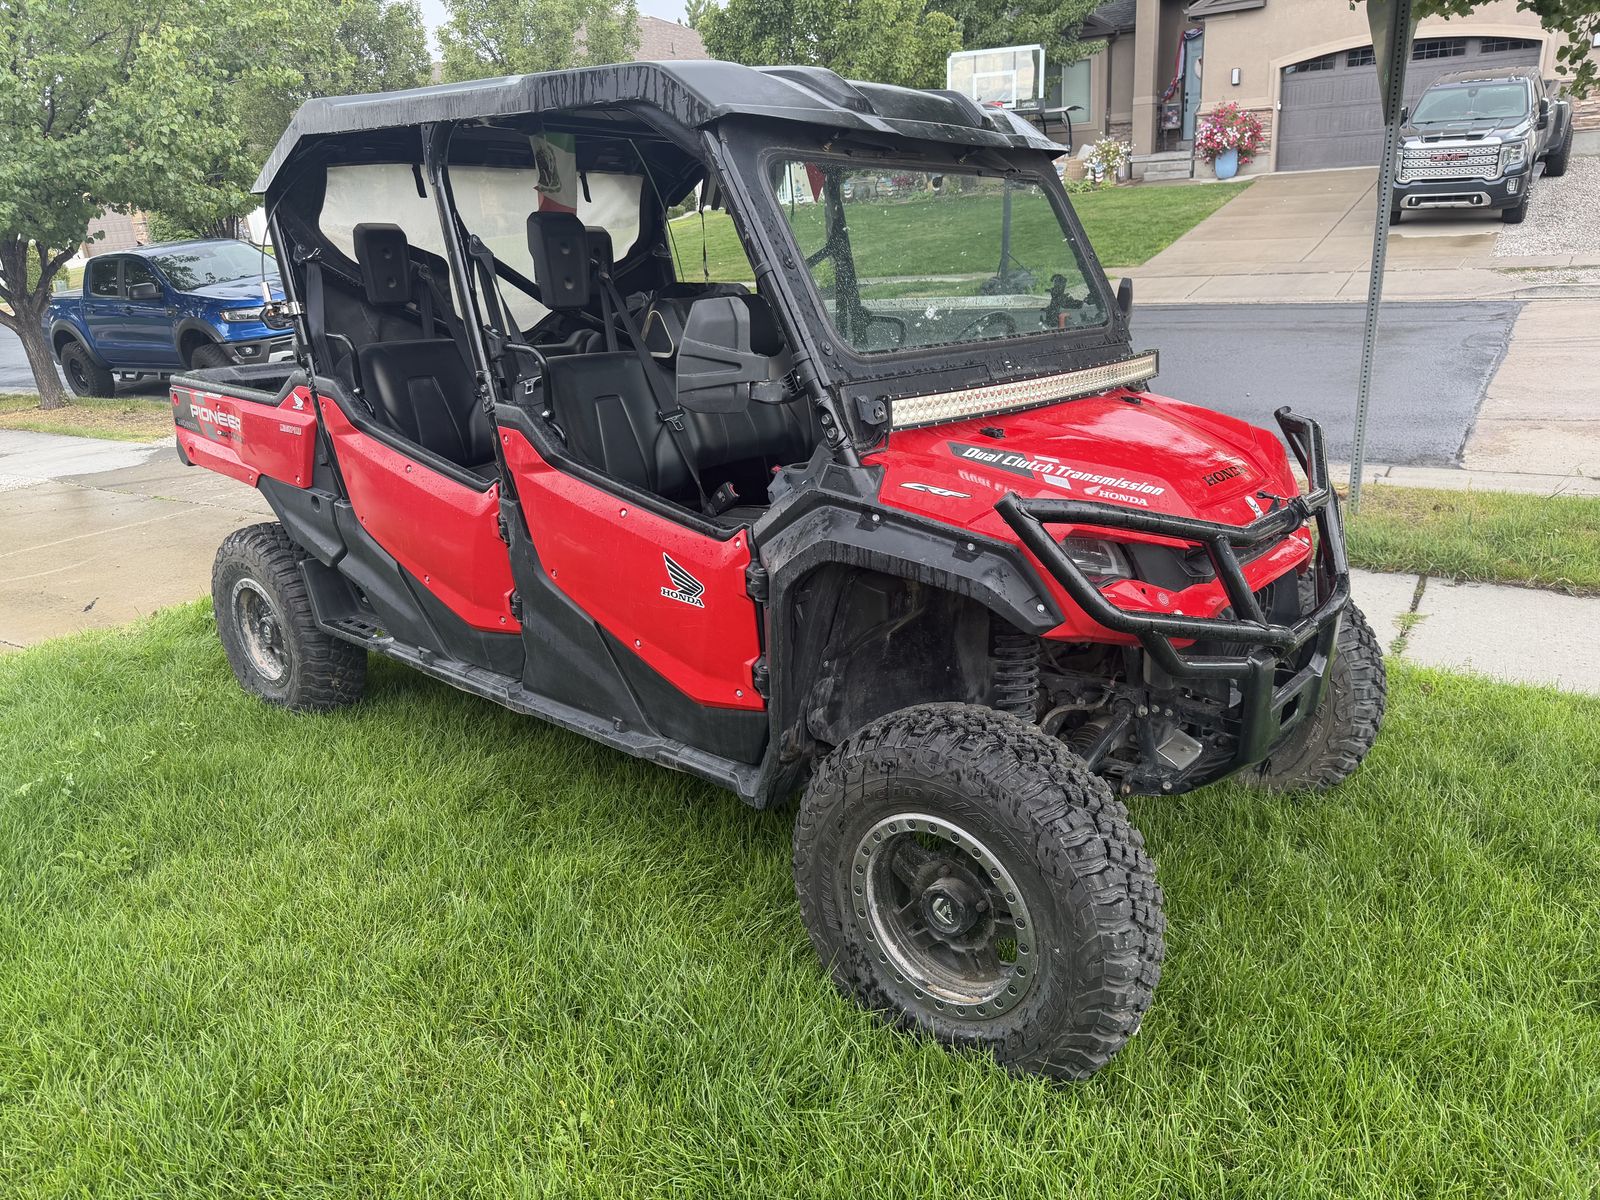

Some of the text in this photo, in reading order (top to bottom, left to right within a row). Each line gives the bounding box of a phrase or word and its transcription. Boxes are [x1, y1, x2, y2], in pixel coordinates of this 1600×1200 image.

[1430, 153, 1468, 162] GMC
[190, 404, 241, 433] PIONEER
[962, 447, 1165, 496] Dual Clutch Transmission
[1202, 464, 1248, 487] HONDA
[1098, 489, 1149, 506] HONDA
[661, 587, 704, 607] HONDA
